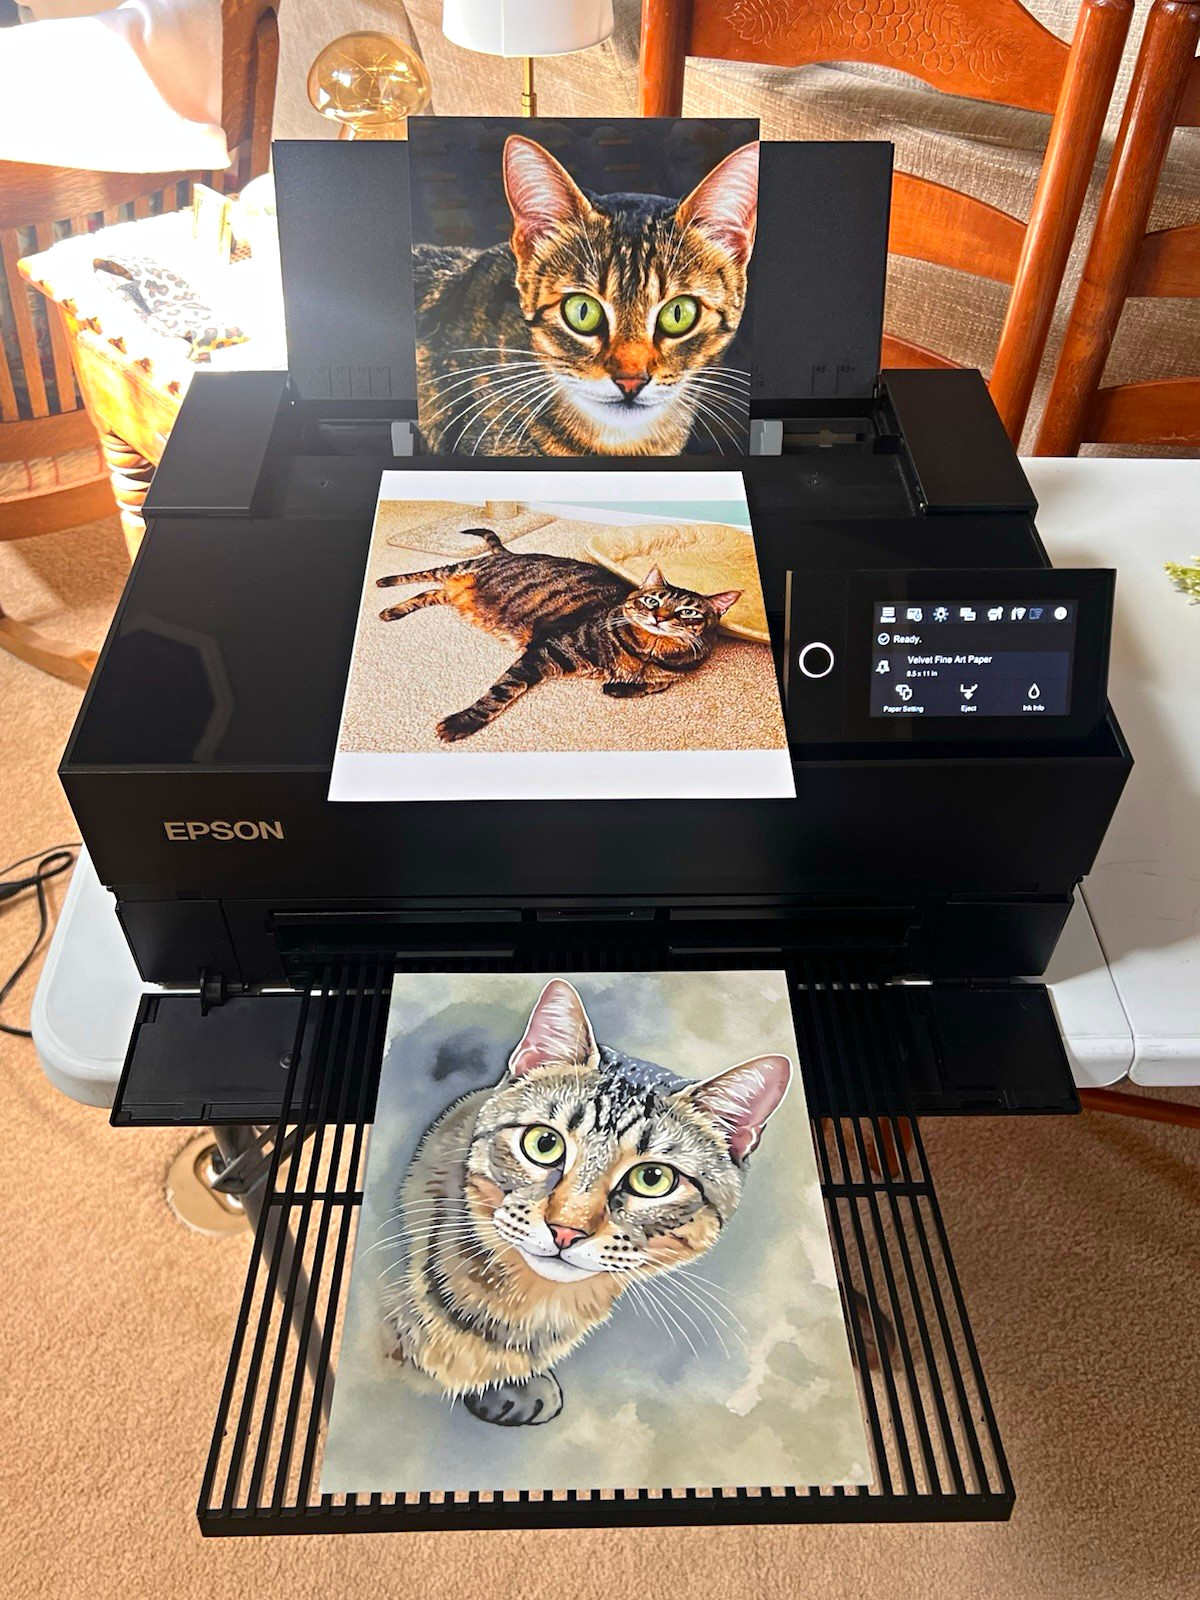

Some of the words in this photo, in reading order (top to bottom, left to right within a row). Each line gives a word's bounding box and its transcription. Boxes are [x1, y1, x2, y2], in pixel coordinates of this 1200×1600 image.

[893, 635, 922, 645] Ready.
[907, 656, 933, 664] Velvet
[934, 655, 953, 664] Fine
[954, 655, 967, 664] Art
[967, 655, 993, 665] Paper
[883, 705, 902, 713] Paper
[902, 705, 925, 713] Setting
[960, 704, 977, 713] Eject
[163, 821, 285, 840] EPSON
